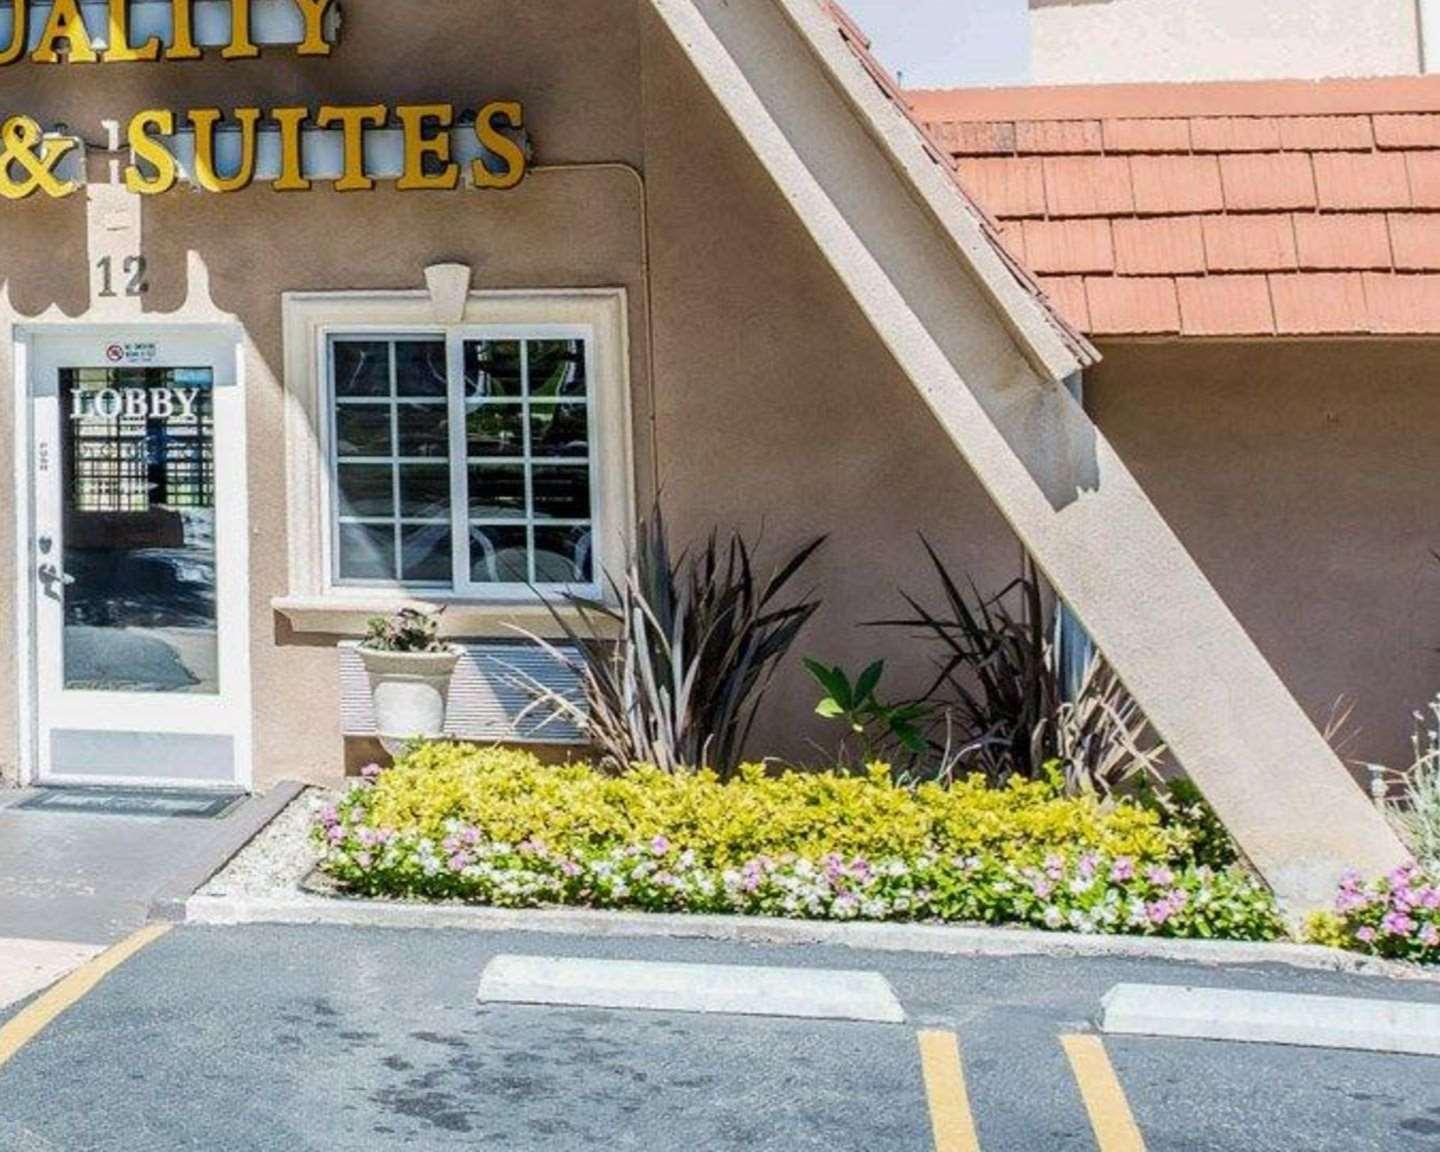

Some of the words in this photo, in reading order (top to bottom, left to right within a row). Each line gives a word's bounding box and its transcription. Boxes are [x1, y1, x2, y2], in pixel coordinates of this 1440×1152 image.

[125, 101, 527, 194] SUITES
[96, 255, 150, 297] 12
[70, 388, 200, 418] LOBBY
